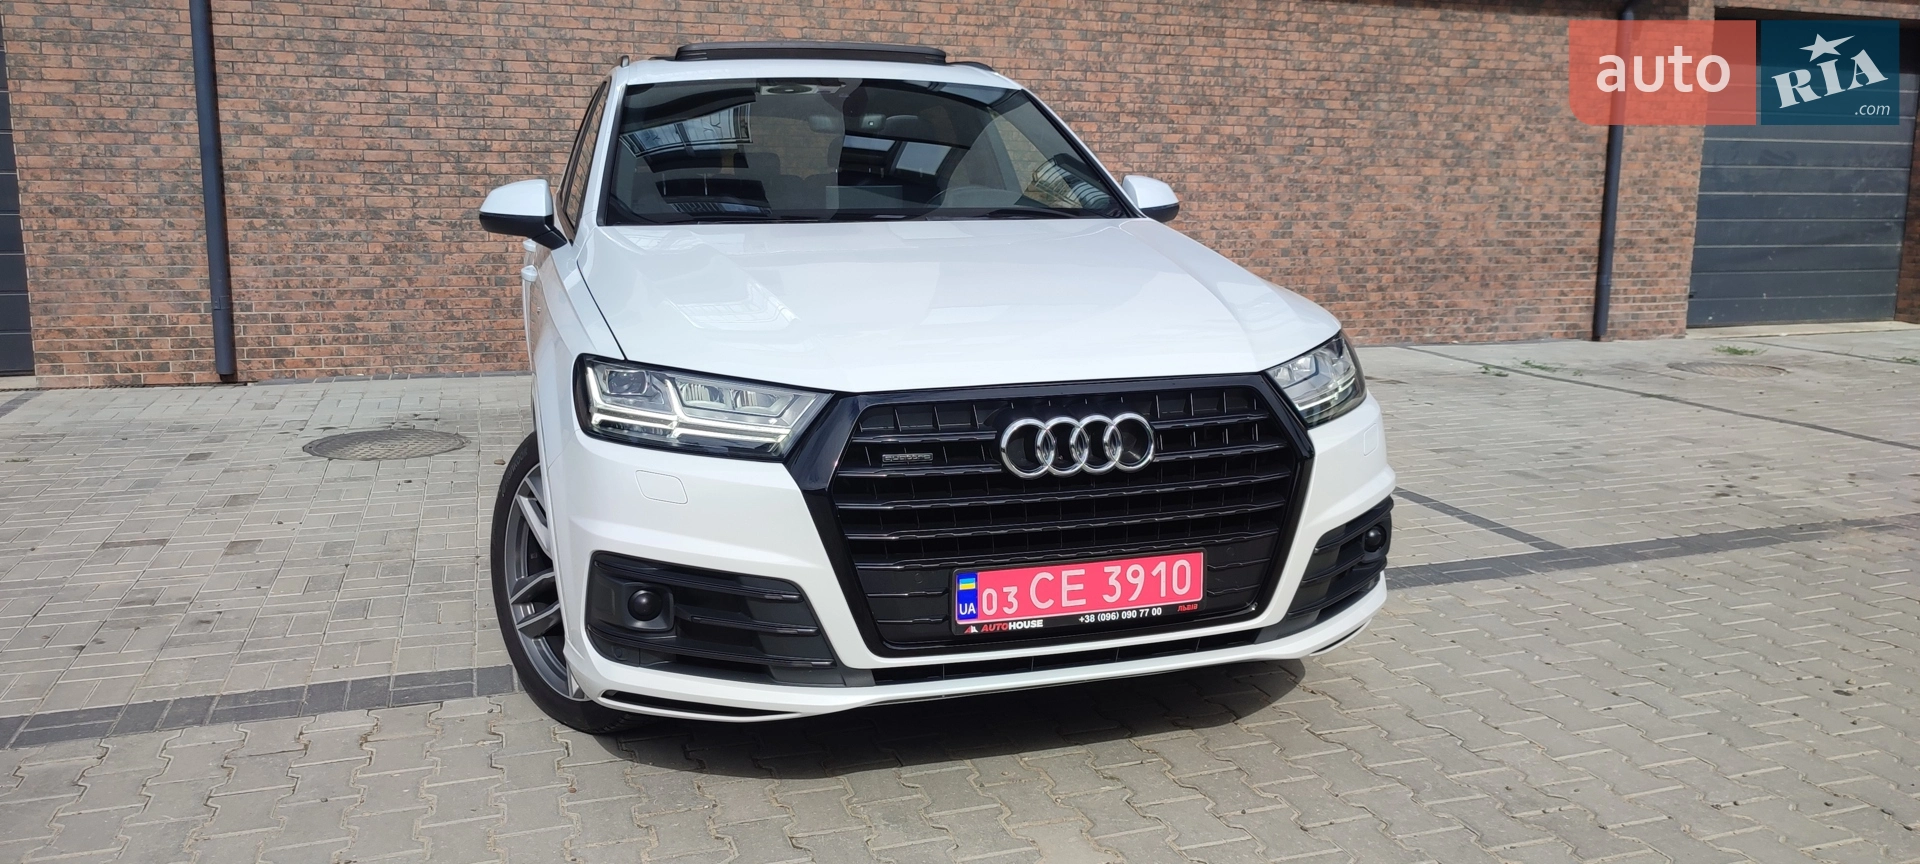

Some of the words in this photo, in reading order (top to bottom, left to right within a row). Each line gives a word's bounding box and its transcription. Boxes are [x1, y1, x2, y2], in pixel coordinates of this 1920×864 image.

[982, 586, 1018, 616] 03
[1029, 569, 1087, 610] CE
[1102, 559, 1191, 603] 3910
[959, 602, 976, 616] UA
[1078, 613, 1096, 623] +38
[1097, 611, 1120, 622] (096)
[1121, 609, 1137, 620] 090
[1139, 607, 1150, 619] 77
[1151, 606, 1163, 617] 00
